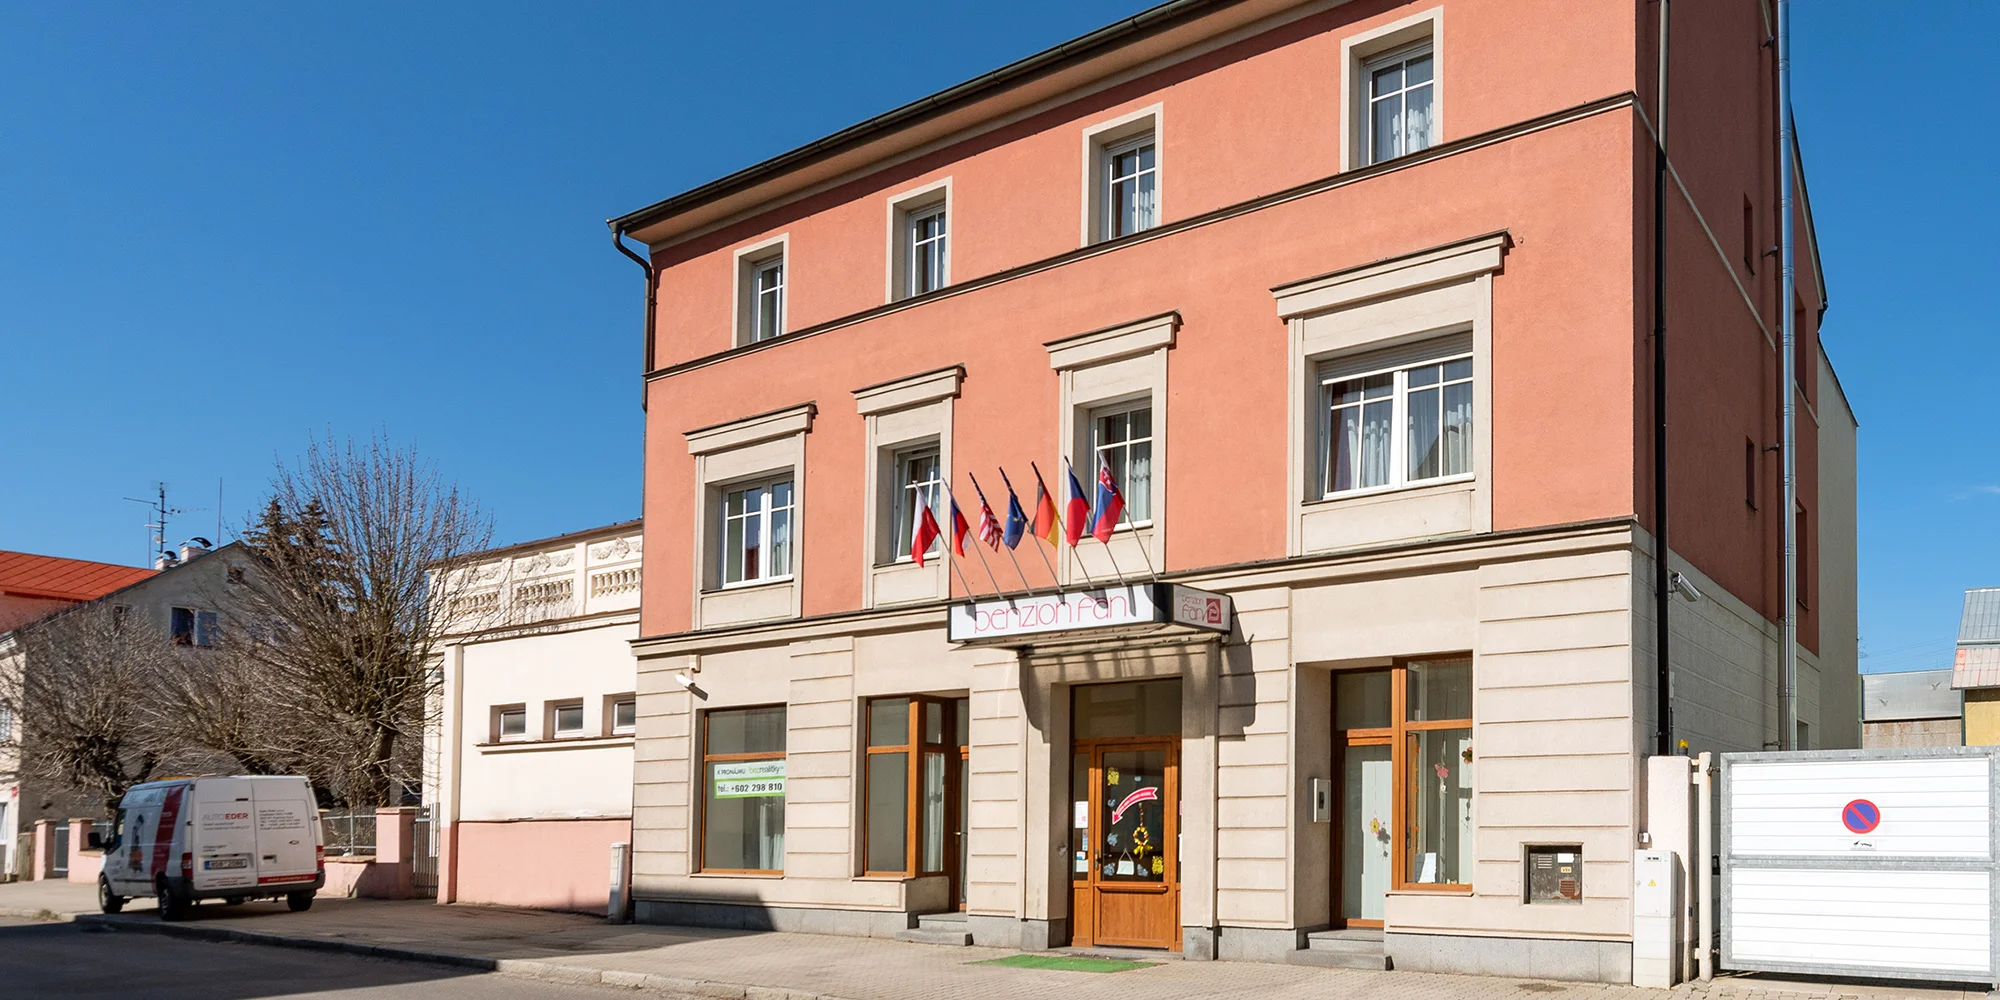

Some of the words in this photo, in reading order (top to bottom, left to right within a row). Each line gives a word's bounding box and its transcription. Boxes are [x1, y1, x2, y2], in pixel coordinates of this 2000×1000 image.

[1181, 594, 1204, 605] penzion
[974, 602, 1072, 634] penzion
[731, 784, 749, 792] +602
[751, 783, 766, 791] 298
[768, 782, 783, 791] 810
